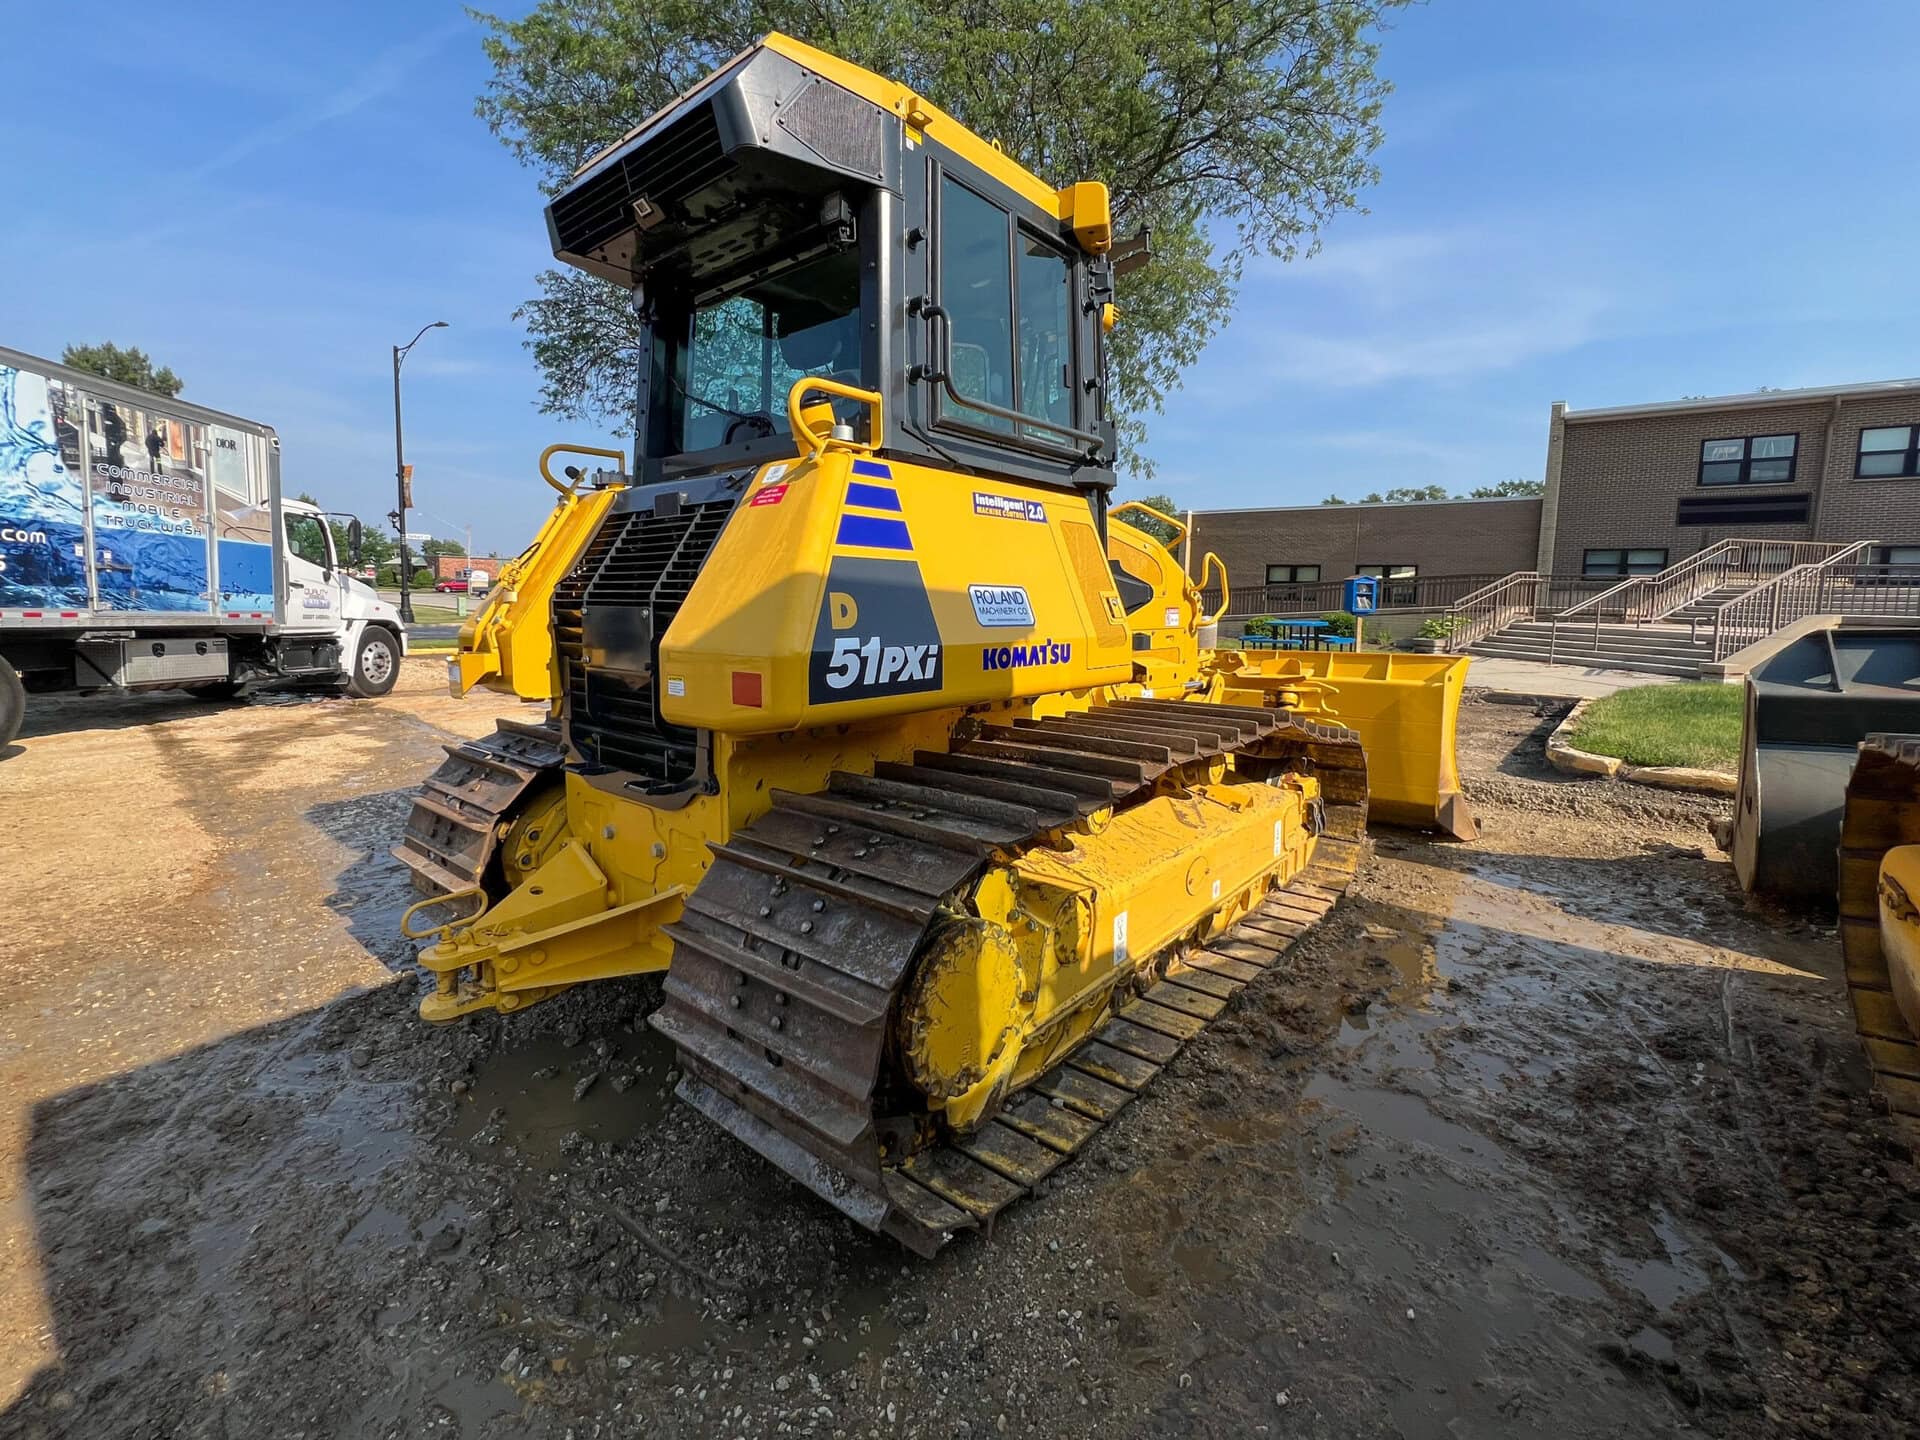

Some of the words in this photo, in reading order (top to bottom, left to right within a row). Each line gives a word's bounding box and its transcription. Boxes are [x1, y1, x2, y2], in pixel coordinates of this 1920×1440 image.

[216, 438, 236, 450] DIOR
[97, 463, 202, 492] COMMERCIAL
[106, 482, 197, 506] INDUSTRIAL
[122, 500, 180, 518] MOBILE
[975, 493, 1025, 511] Intelligent
[1028, 504, 1044, 520] 2.0
[103, 514, 153, 530] TRUCK
[160, 523, 202, 536] WASH
[974, 590, 1024, 605] ROLAND
[829, 591, 858, 630] D
[979, 606, 1017, 616] MACHINERY
[826, 636, 939, 689] 51PXi
[983, 638, 1070, 671] KOMATSU
